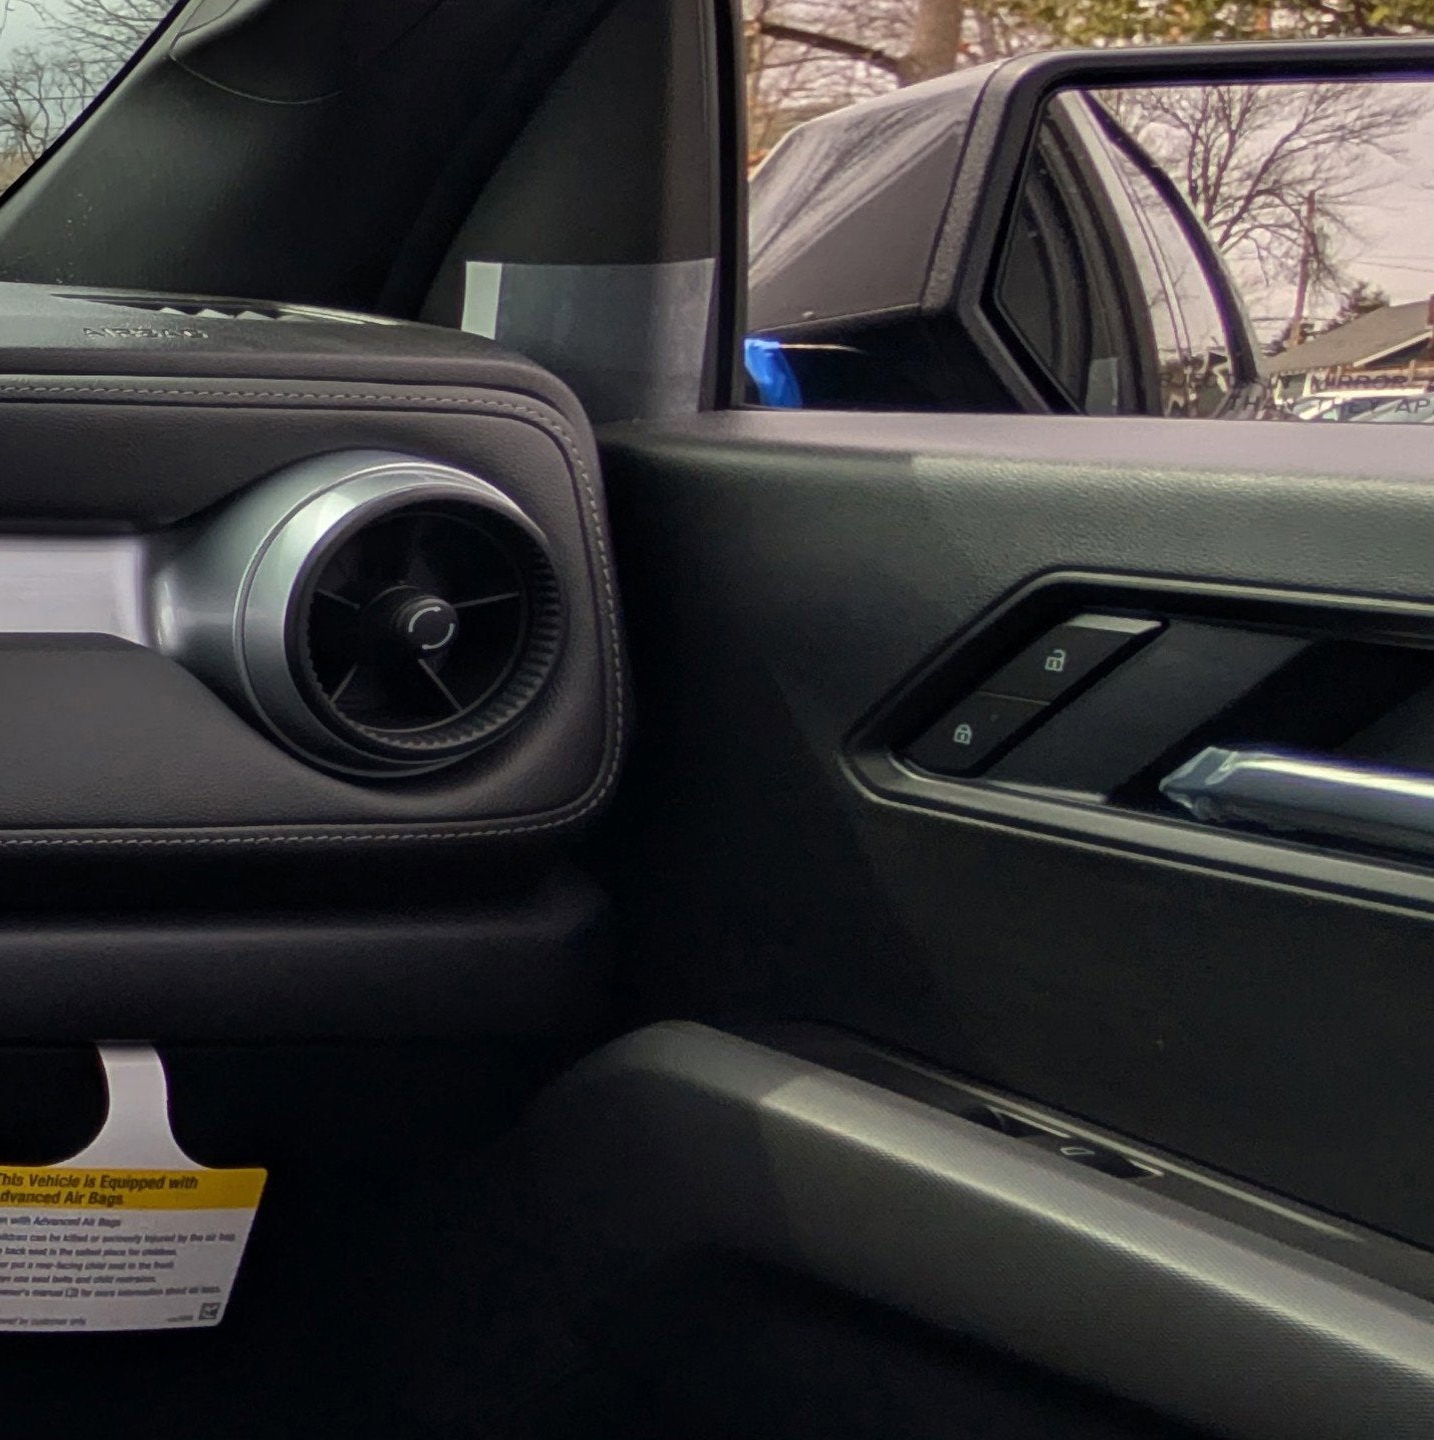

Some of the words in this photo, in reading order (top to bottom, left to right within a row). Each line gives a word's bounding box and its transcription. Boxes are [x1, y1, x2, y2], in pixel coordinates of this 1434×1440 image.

[29, 1173, 81, 1187] Vehicle
[100, 1175, 165, 1191] Equipped
[169, 1176, 199, 1189] with
[64, 1191, 85, 1204] Air
[88, 1192, 123, 1207] Bags
